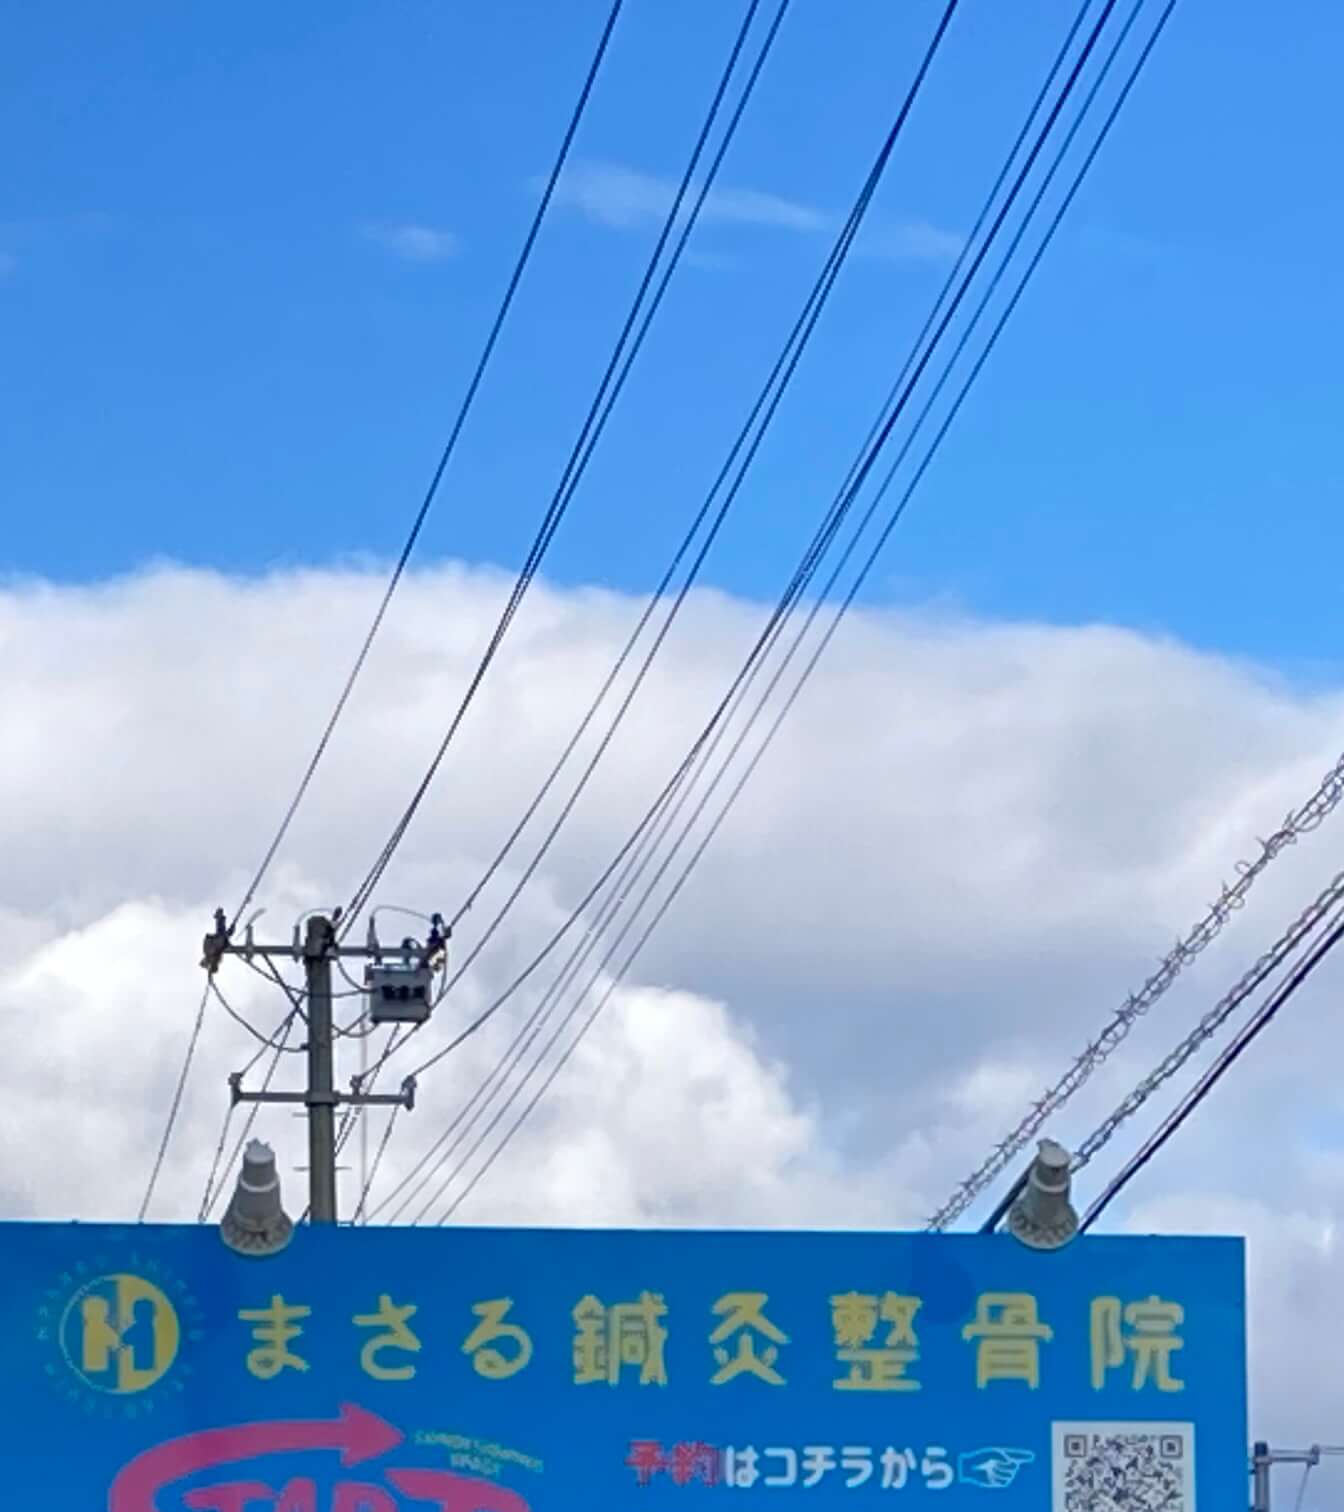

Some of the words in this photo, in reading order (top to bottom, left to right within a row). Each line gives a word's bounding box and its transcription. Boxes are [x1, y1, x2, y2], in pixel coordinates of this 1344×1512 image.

[237, 1290, 1185, 1392] まさる鍼灸整骨院
[624, 1439, 955, 1489] 予約はコチラから
